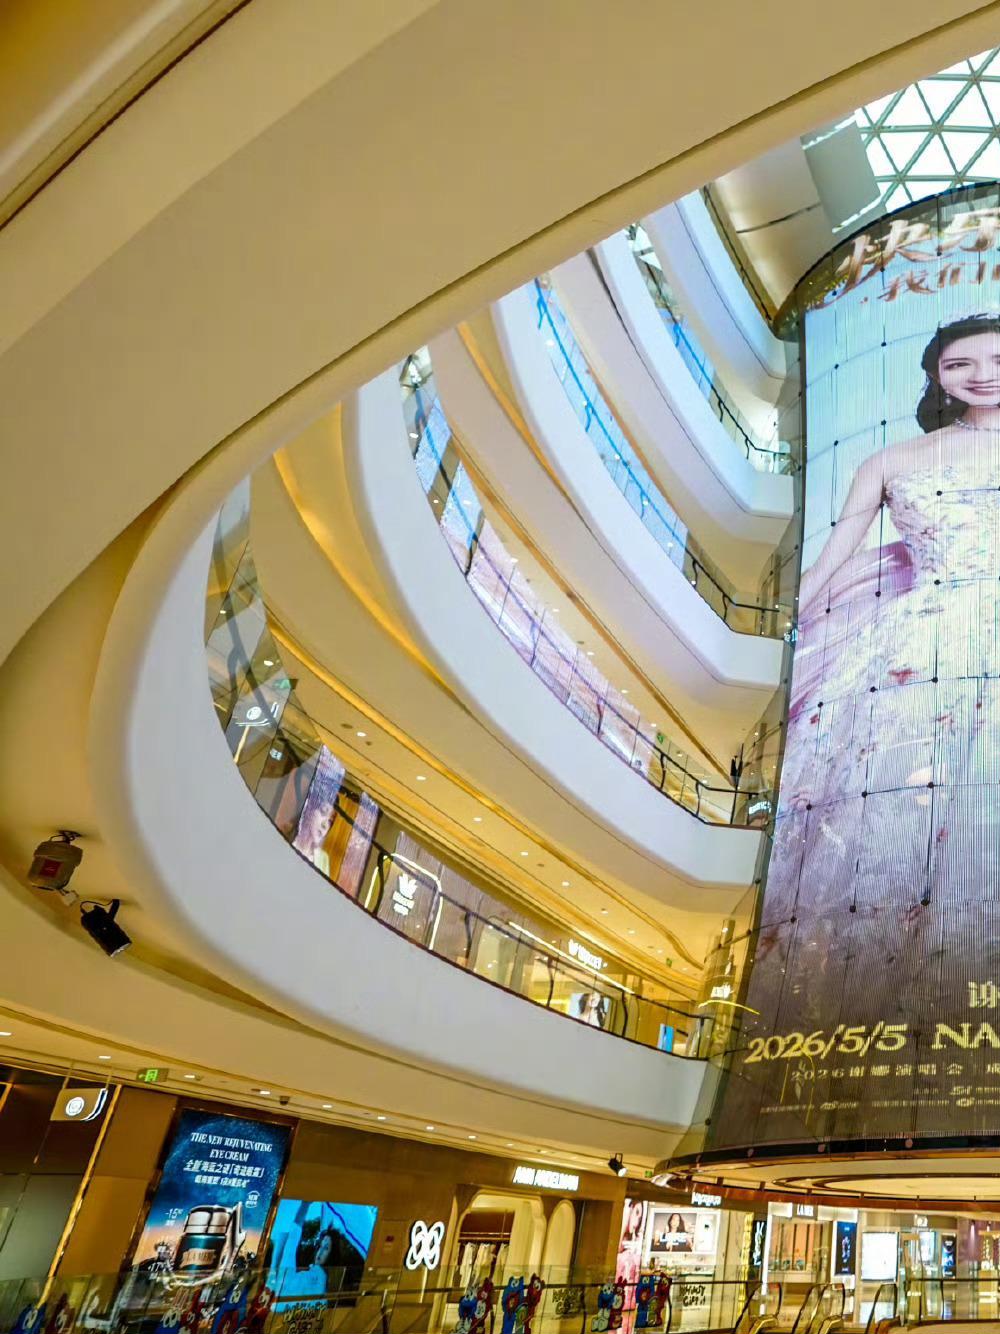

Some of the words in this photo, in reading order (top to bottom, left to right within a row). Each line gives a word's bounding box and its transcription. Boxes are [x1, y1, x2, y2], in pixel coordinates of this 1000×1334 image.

[744, 1021, 908, 1063] 2026/5/5
[190, 1132, 207, 1143] THE
[209, 1148, 224, 1159] EYE
[225, 1150, 250, 1163] CREAM
